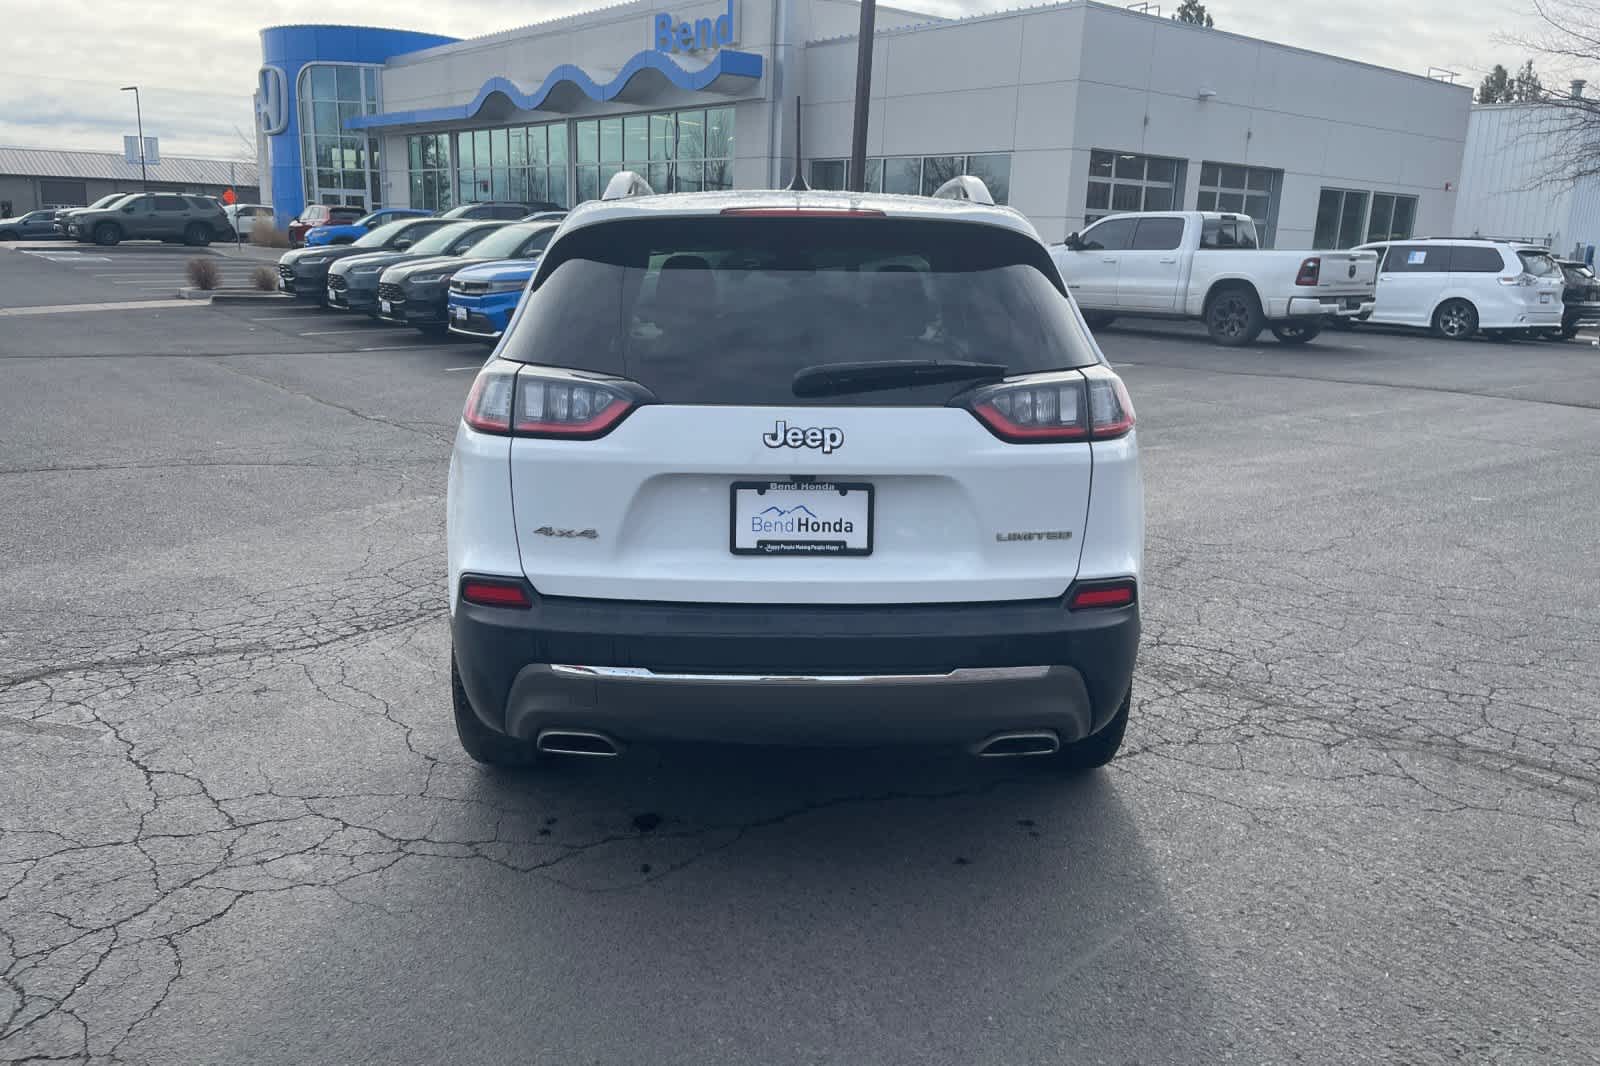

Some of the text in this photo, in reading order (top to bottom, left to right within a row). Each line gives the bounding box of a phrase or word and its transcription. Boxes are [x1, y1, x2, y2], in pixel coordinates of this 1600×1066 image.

[655, 0, 734, 52] Bend
[763, 420, 844, 454] Jeep
[770, 482, 836, 491] Bend Honda
[996, 530, 1073, 542] LIMITED
